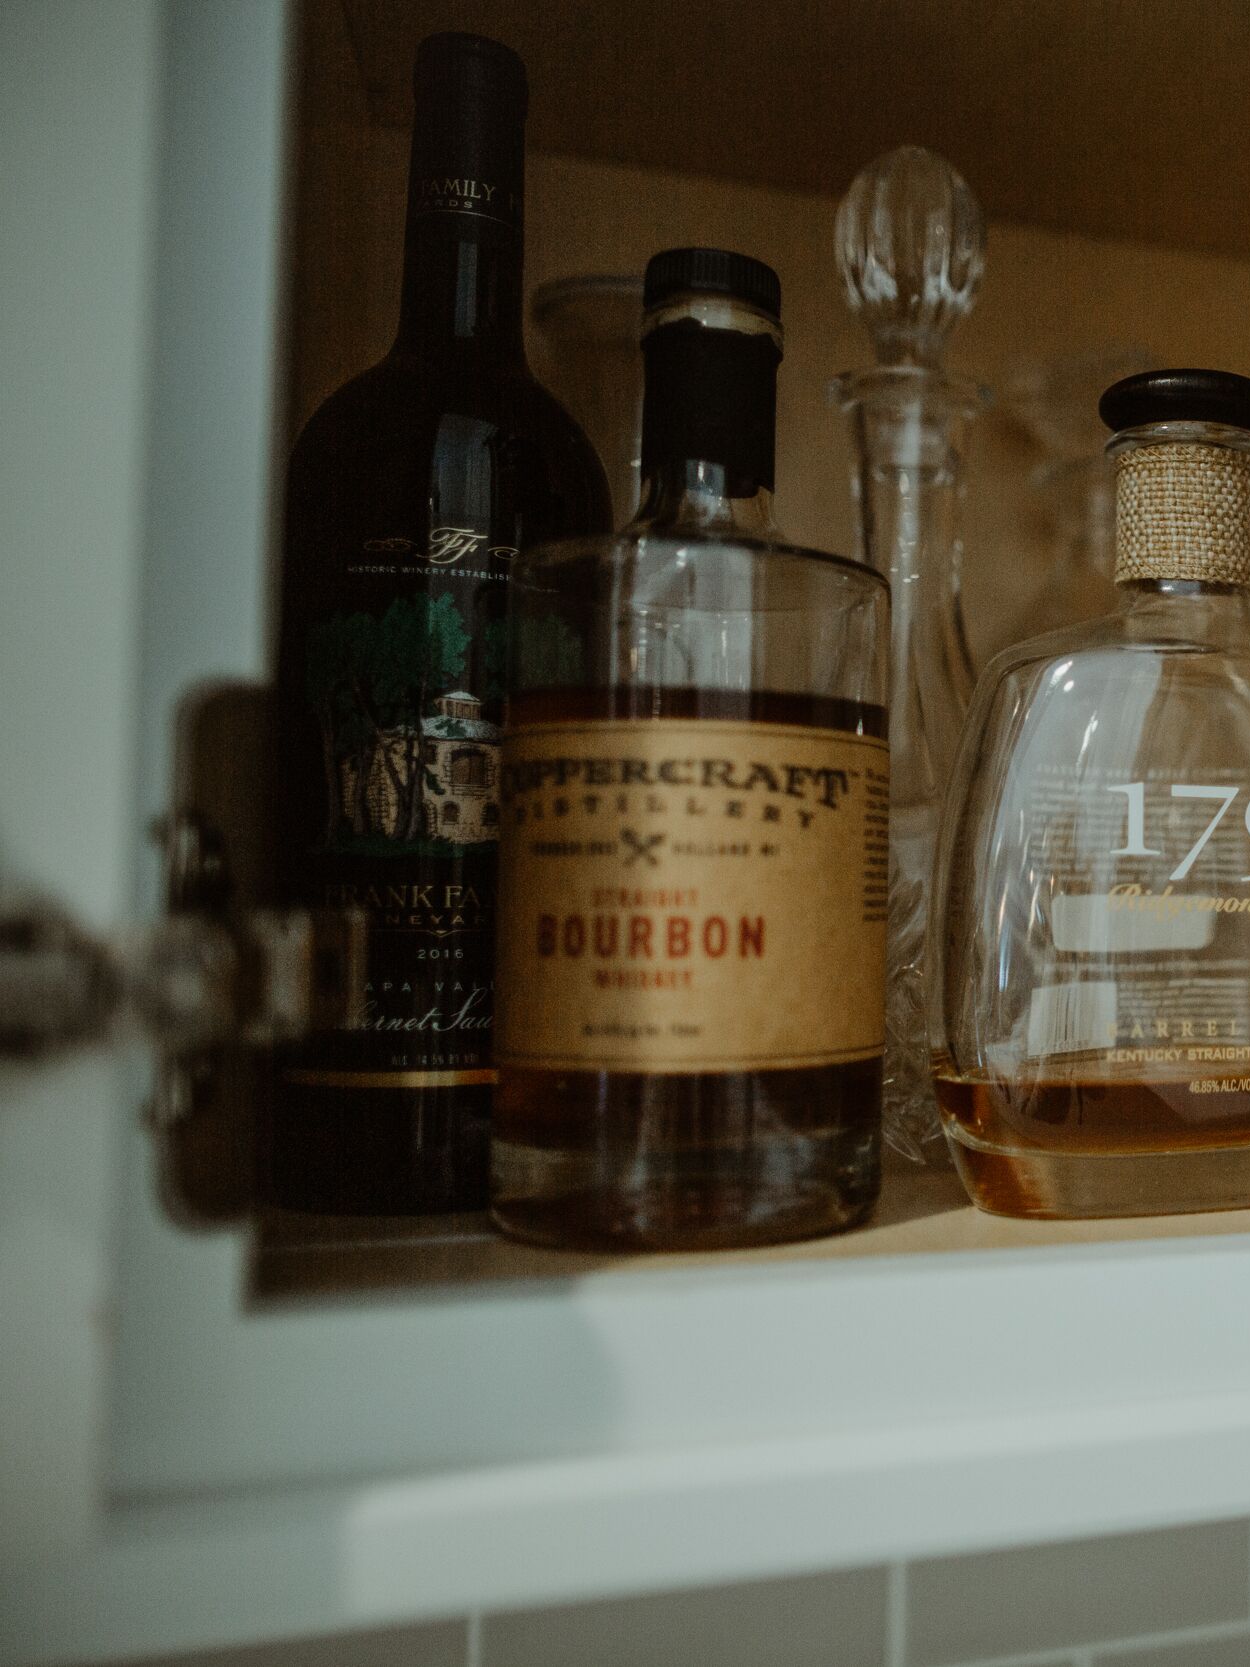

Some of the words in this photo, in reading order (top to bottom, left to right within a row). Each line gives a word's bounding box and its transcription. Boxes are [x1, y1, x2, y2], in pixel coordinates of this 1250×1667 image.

[402, 567, 446, 577] WINERY
[537, 913, 766, 959] BOURBON
[416, 948, 464, 960] 2016
[1107, 1018, 1241, 1040] BARREL
[1106, 1049, 1182, 1063] KENTUCKY
[1189, 1079, 1220, 1094] 46.85%
